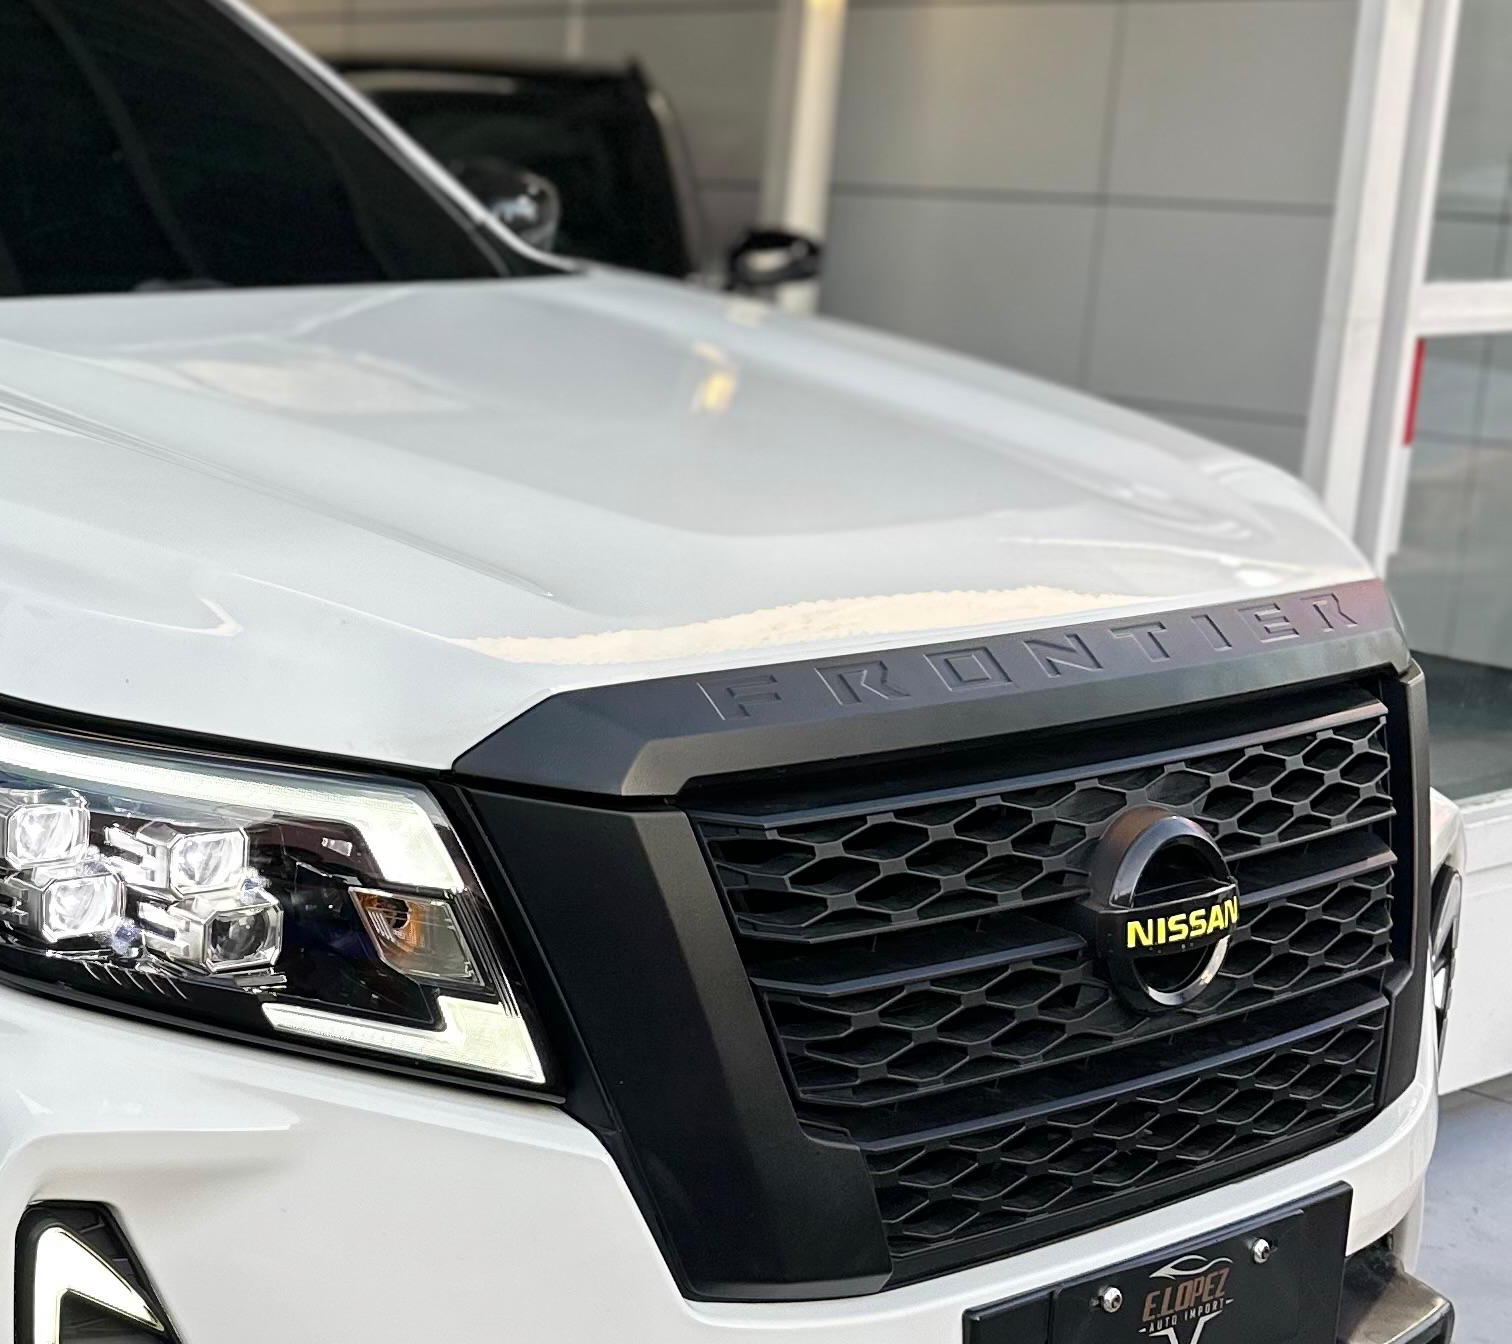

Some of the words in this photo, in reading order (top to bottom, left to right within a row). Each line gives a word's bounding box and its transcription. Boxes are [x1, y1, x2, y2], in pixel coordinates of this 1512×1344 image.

[696, 592, 1360, 721] FRONTIER
[1126, 896, 1240, 949] NISSAN
[1149, 1315, 1178, 1333] AUTO
[1184, 1298, 1225, 1321] IMPORT
